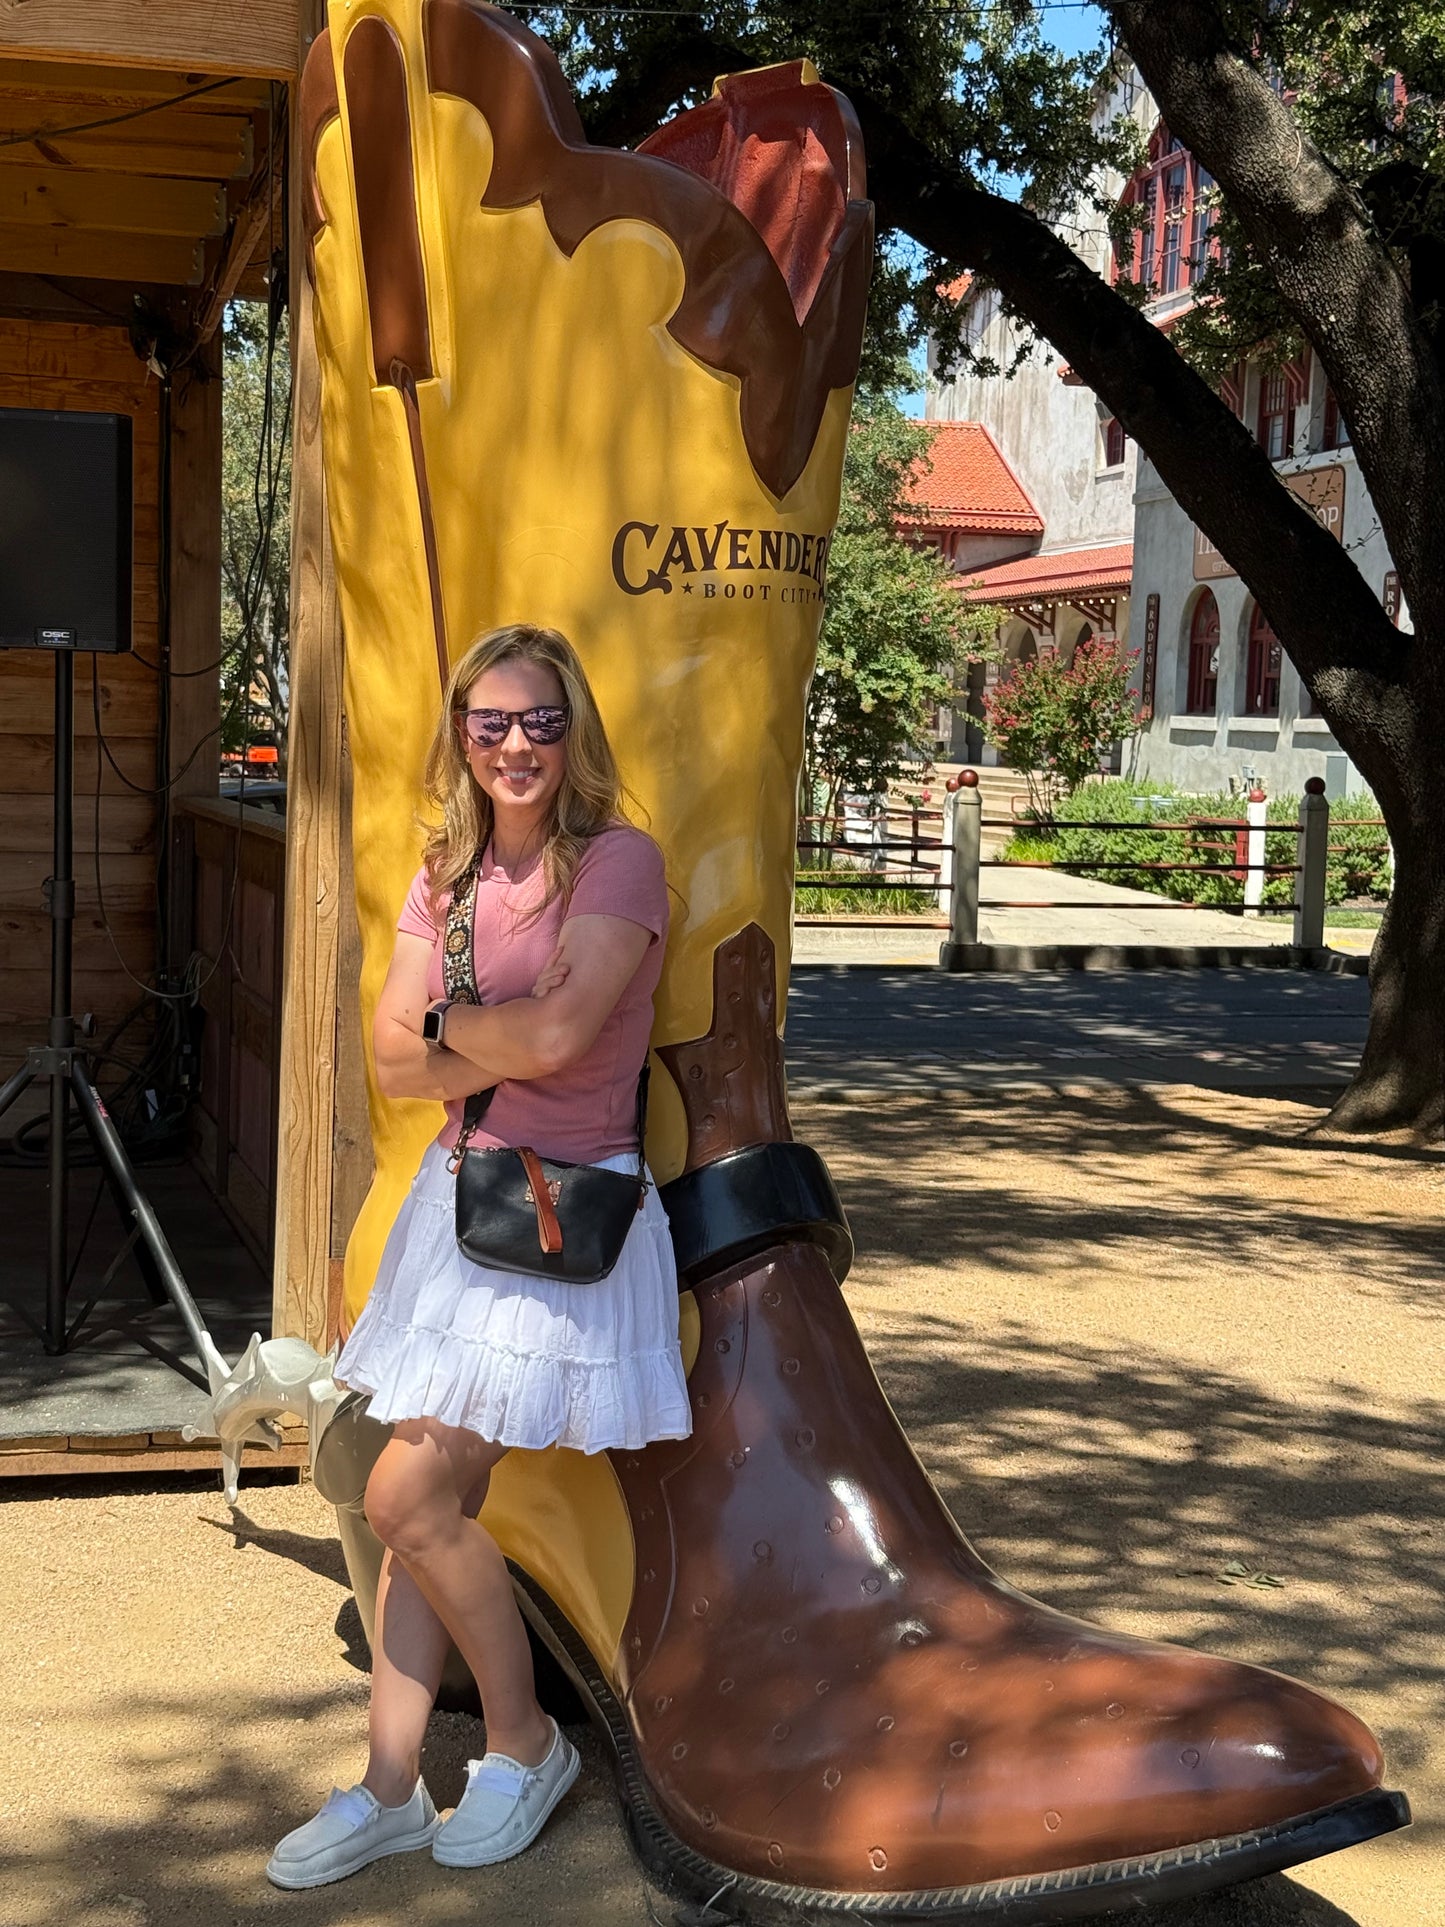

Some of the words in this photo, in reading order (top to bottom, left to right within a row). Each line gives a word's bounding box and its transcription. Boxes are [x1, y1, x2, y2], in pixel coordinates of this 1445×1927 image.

[612, 520, 827, 596] CAVENDER
[703, 583, 771, 600] BOOT
[781, 587, 811, 605] CITY
[1146, 609, 1155, 665] RODEO
